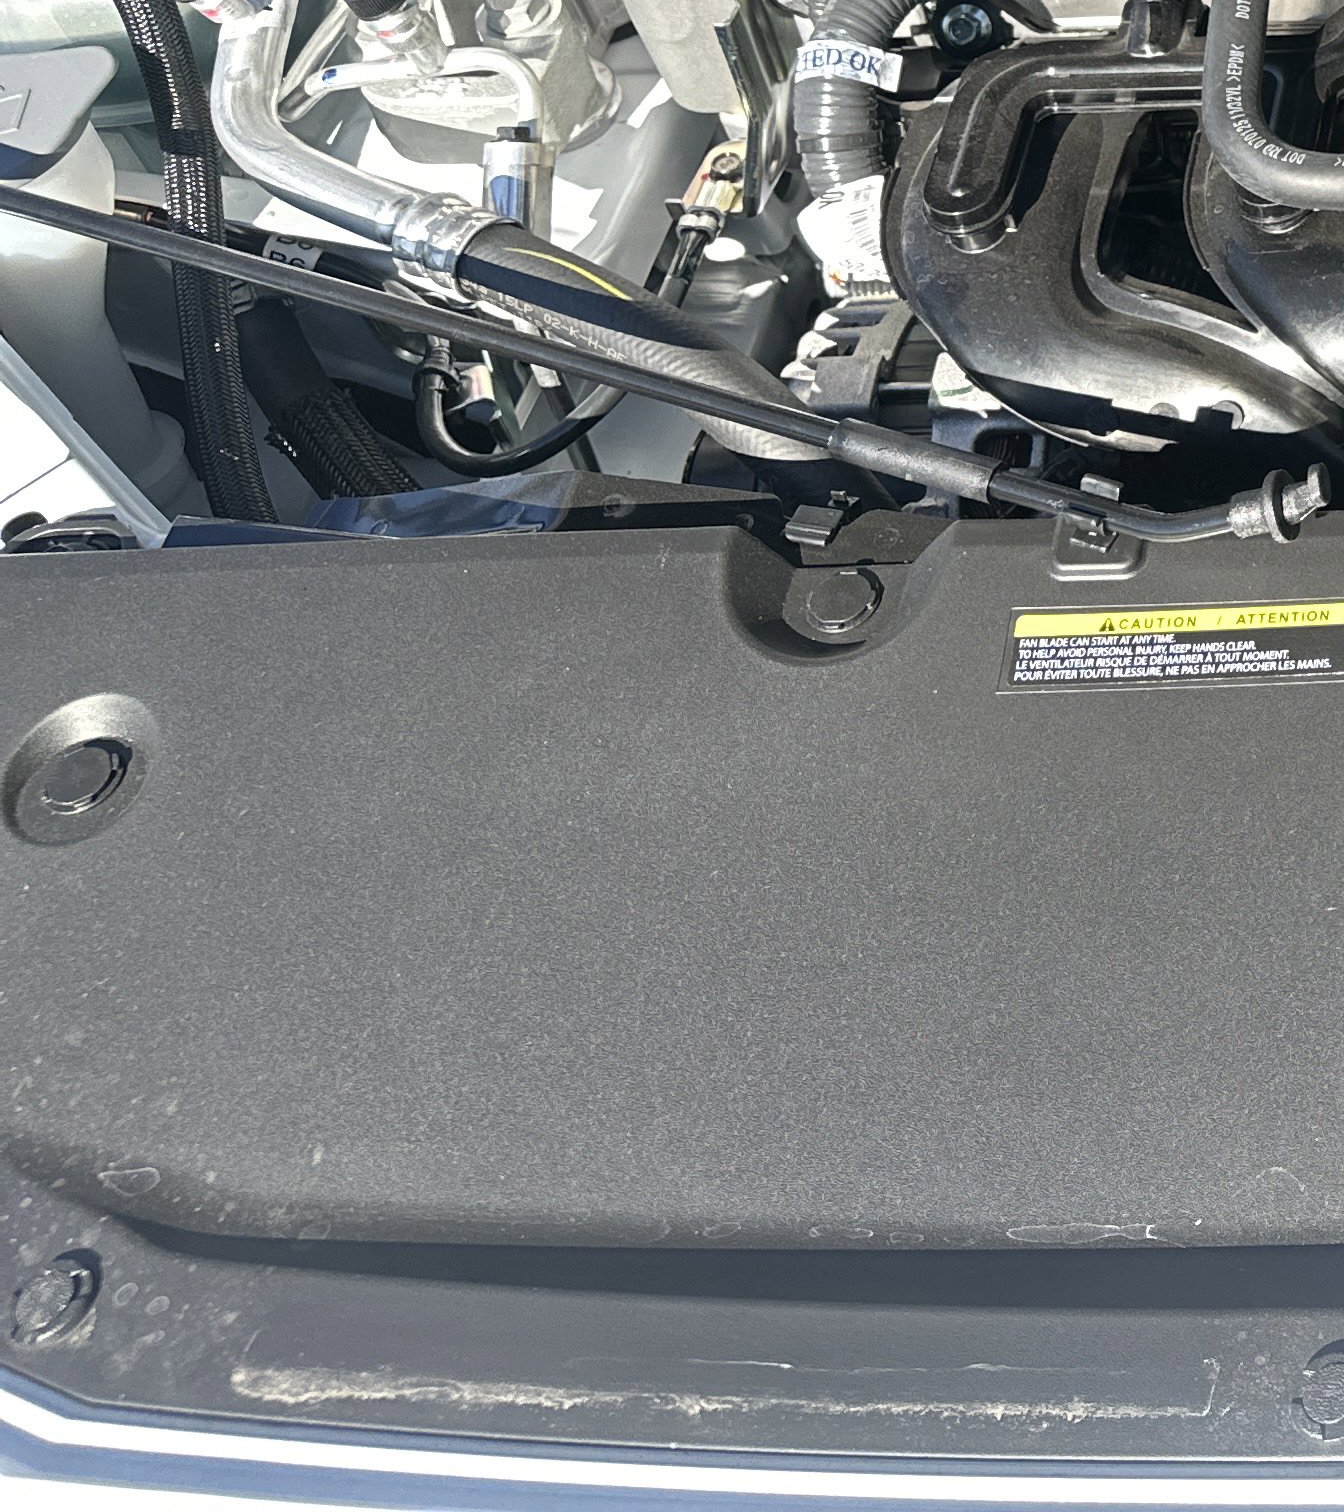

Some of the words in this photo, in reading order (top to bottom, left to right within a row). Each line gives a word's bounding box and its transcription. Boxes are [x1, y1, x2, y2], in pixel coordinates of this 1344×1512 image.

[849, 50, 882, 75] OK
[1232, 119, 1267, 150] 070125
[1280, 149, 1307, 165] DOT
[1119, 615, 1197, 630] CAUTION
[1235, 610, 1330, 625] ATTENTION
[1018, 649, 1032, 659] TO
[1032, 649, 1057, 658] HELP
[1057, 648, 1086, 657] AVOID
[1087, 646, 1134, 657] PERSONAL
[1135, 645, 1168, 656] INJURY,
[1169, 644, 1192, 654] KEEP
[1192, 642, 1225, 652] HANDS
[1225, 640, 1257, 651] CLEAR.
[1019, 639, 1038, 648] FAN
[1038, 638, 1069, 648] BLADE
[1069, 637, 1090, 647] CAN
[1090, 636, 1120, 646] START
[1120, 635, 1132, 645] AT
[1133, 635, 1153, 644] ANY
[1153, 634, 1177, 644] TIME.
[1013, 670, 1043, 681] POUR
[1044, 668, 1078, 680] ÉVITER
[1079, 668, 1111, 679] TOUTE
[1113, 666, 1164, 678] BLESSURE,
[1165, 666, 1179, 676] NE
[1181, 665, 1200, 675] PAS
[1201, 664, 1215, 674] EN
[1216, 661, 1277, 673] APPROCHER
[1278, 660, 1296, 670] LES
[1297, 658, 1332, 669] MAINS.
[1015, 660, 1028, 670] LE
[1029, 658, 1094, 669] VENTILATEUR
[1095, 657, 1132, 668] RISQUE
[1133, 656, 1148, 666] DE
[1149, 652, 1203, 665] DÉMARRER
[1204, 652, 1213, 663] À
[1215, 651, 1241, 662] TOUT
[1242, 650, 1290, 662] MOMENT.
